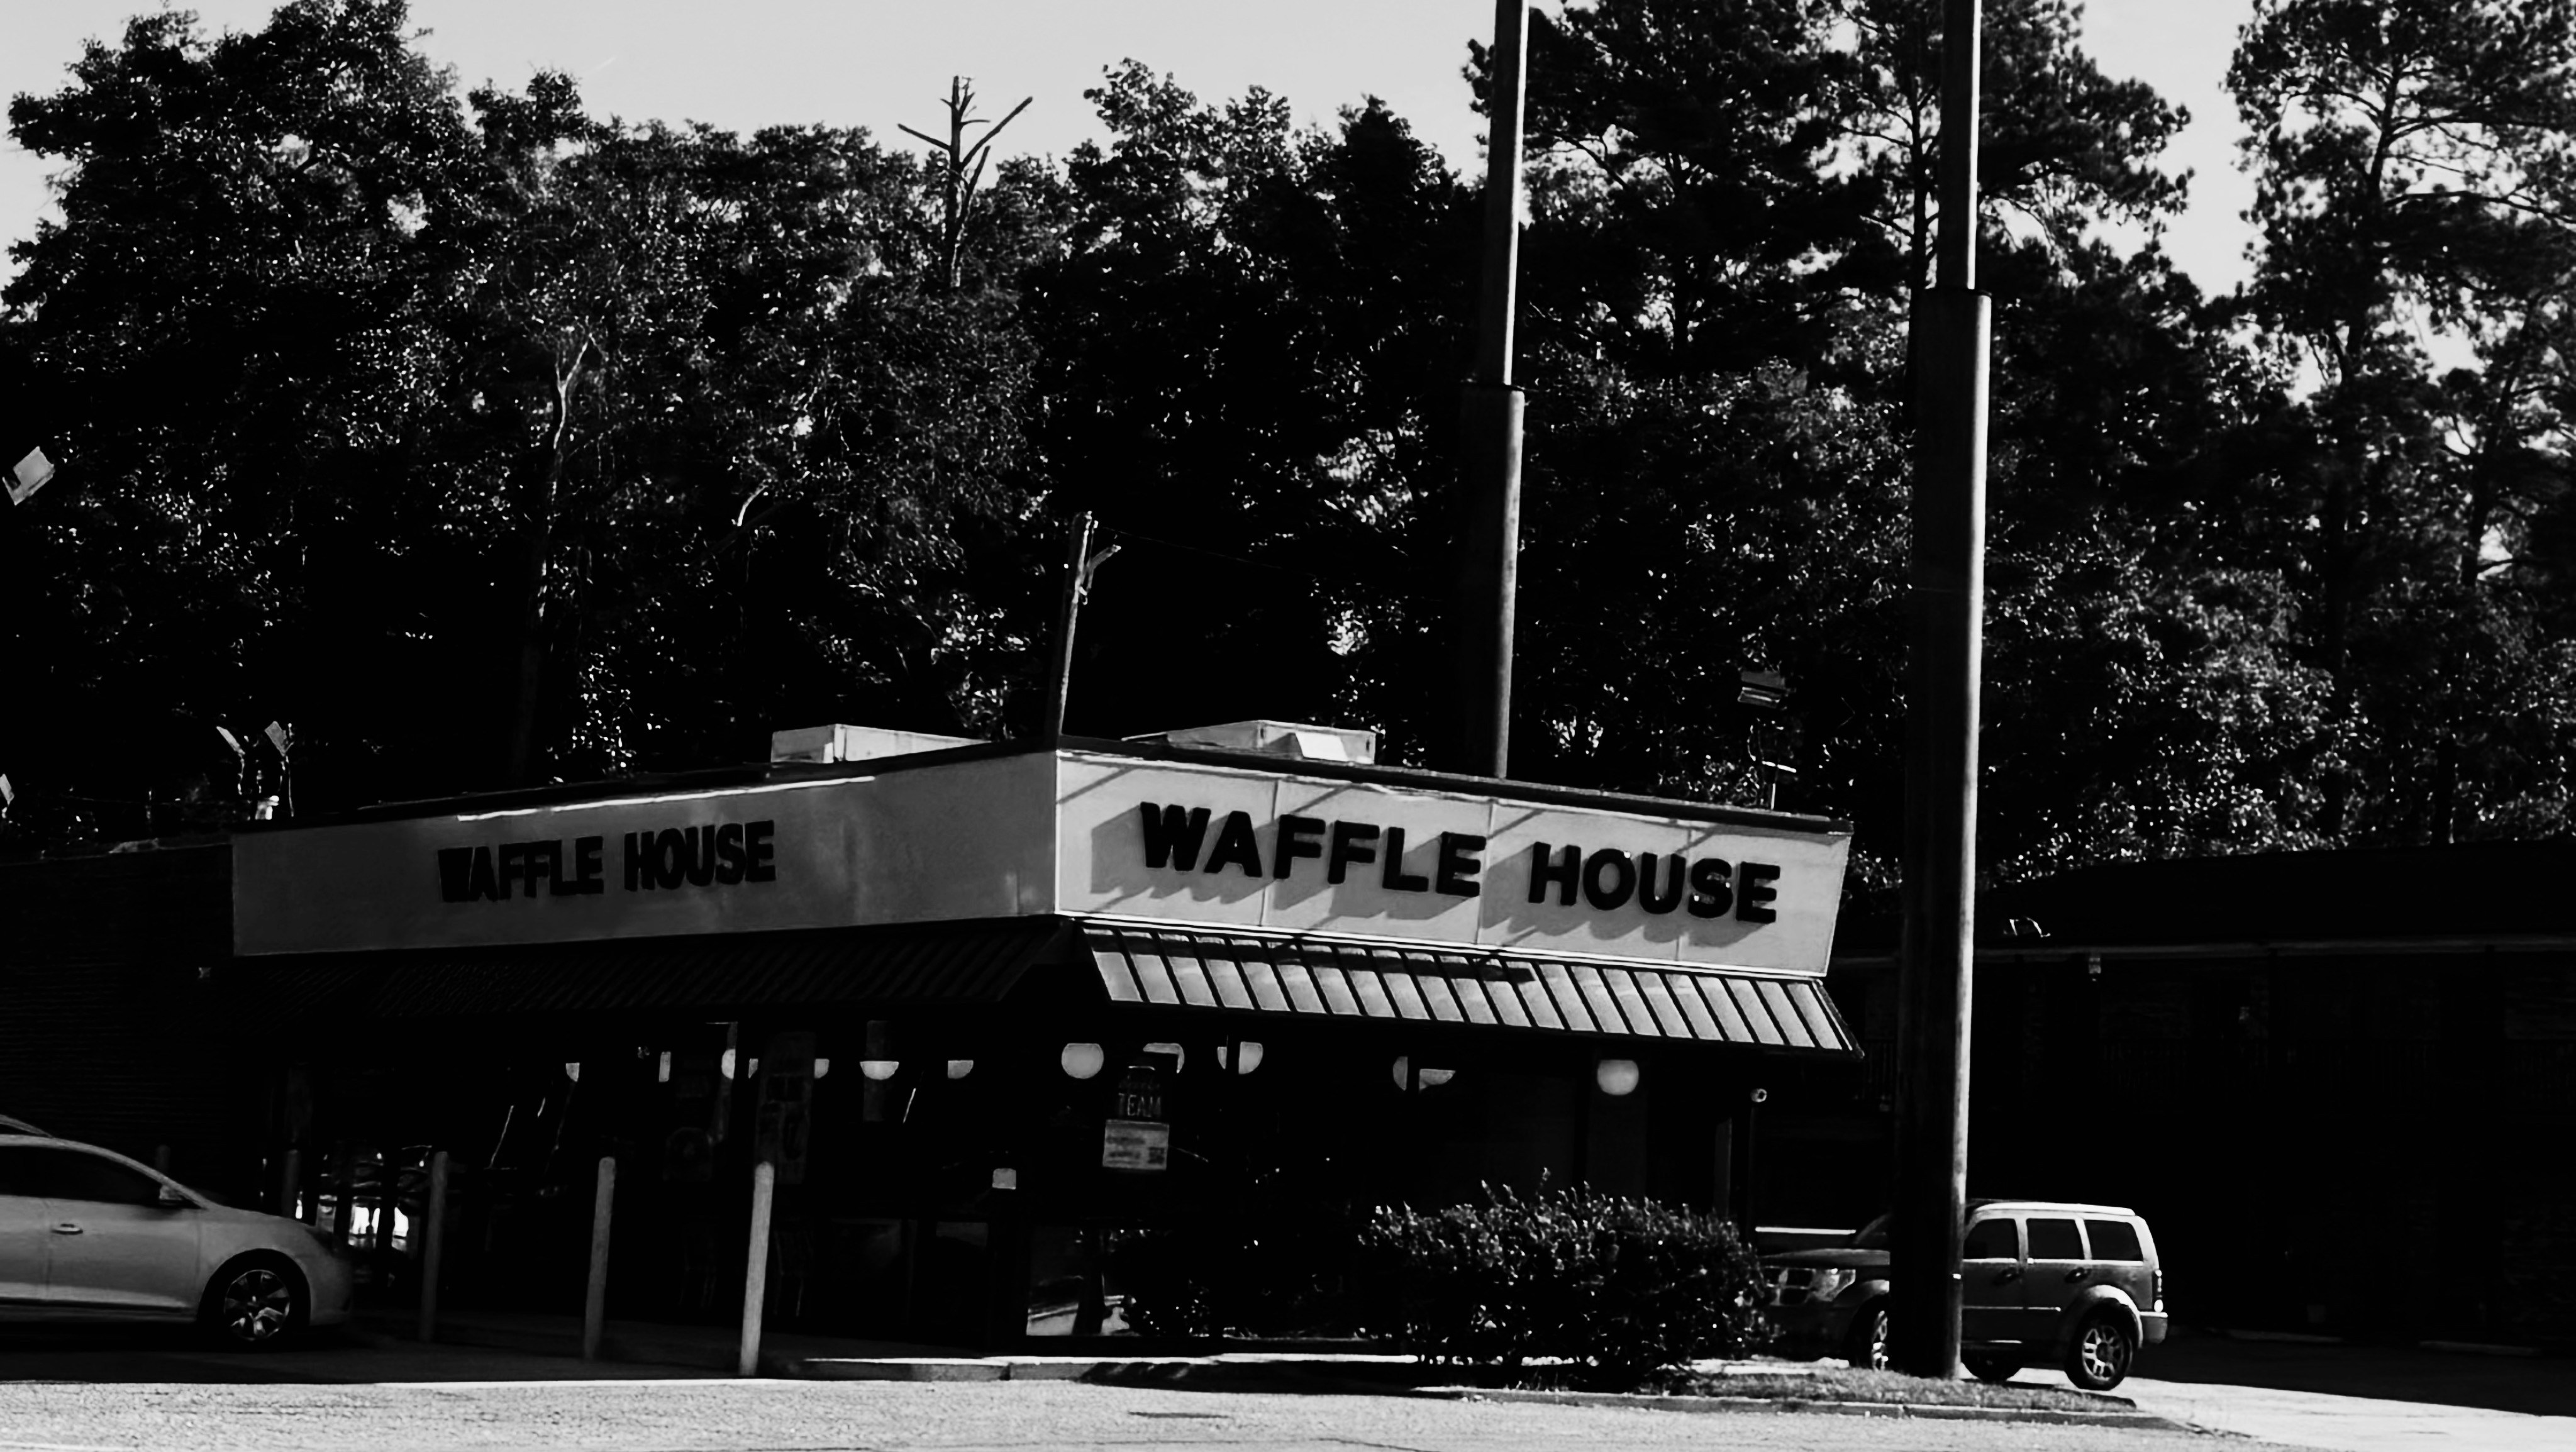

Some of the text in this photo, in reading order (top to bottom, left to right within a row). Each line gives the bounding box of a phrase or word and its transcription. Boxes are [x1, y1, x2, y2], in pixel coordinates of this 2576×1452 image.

[624, 819, 776, 892] HOUSE
[1140, 801, 1781, 924] WAFFLE HOUSE
[1118, 1092, 1162, 1118] TEAM
